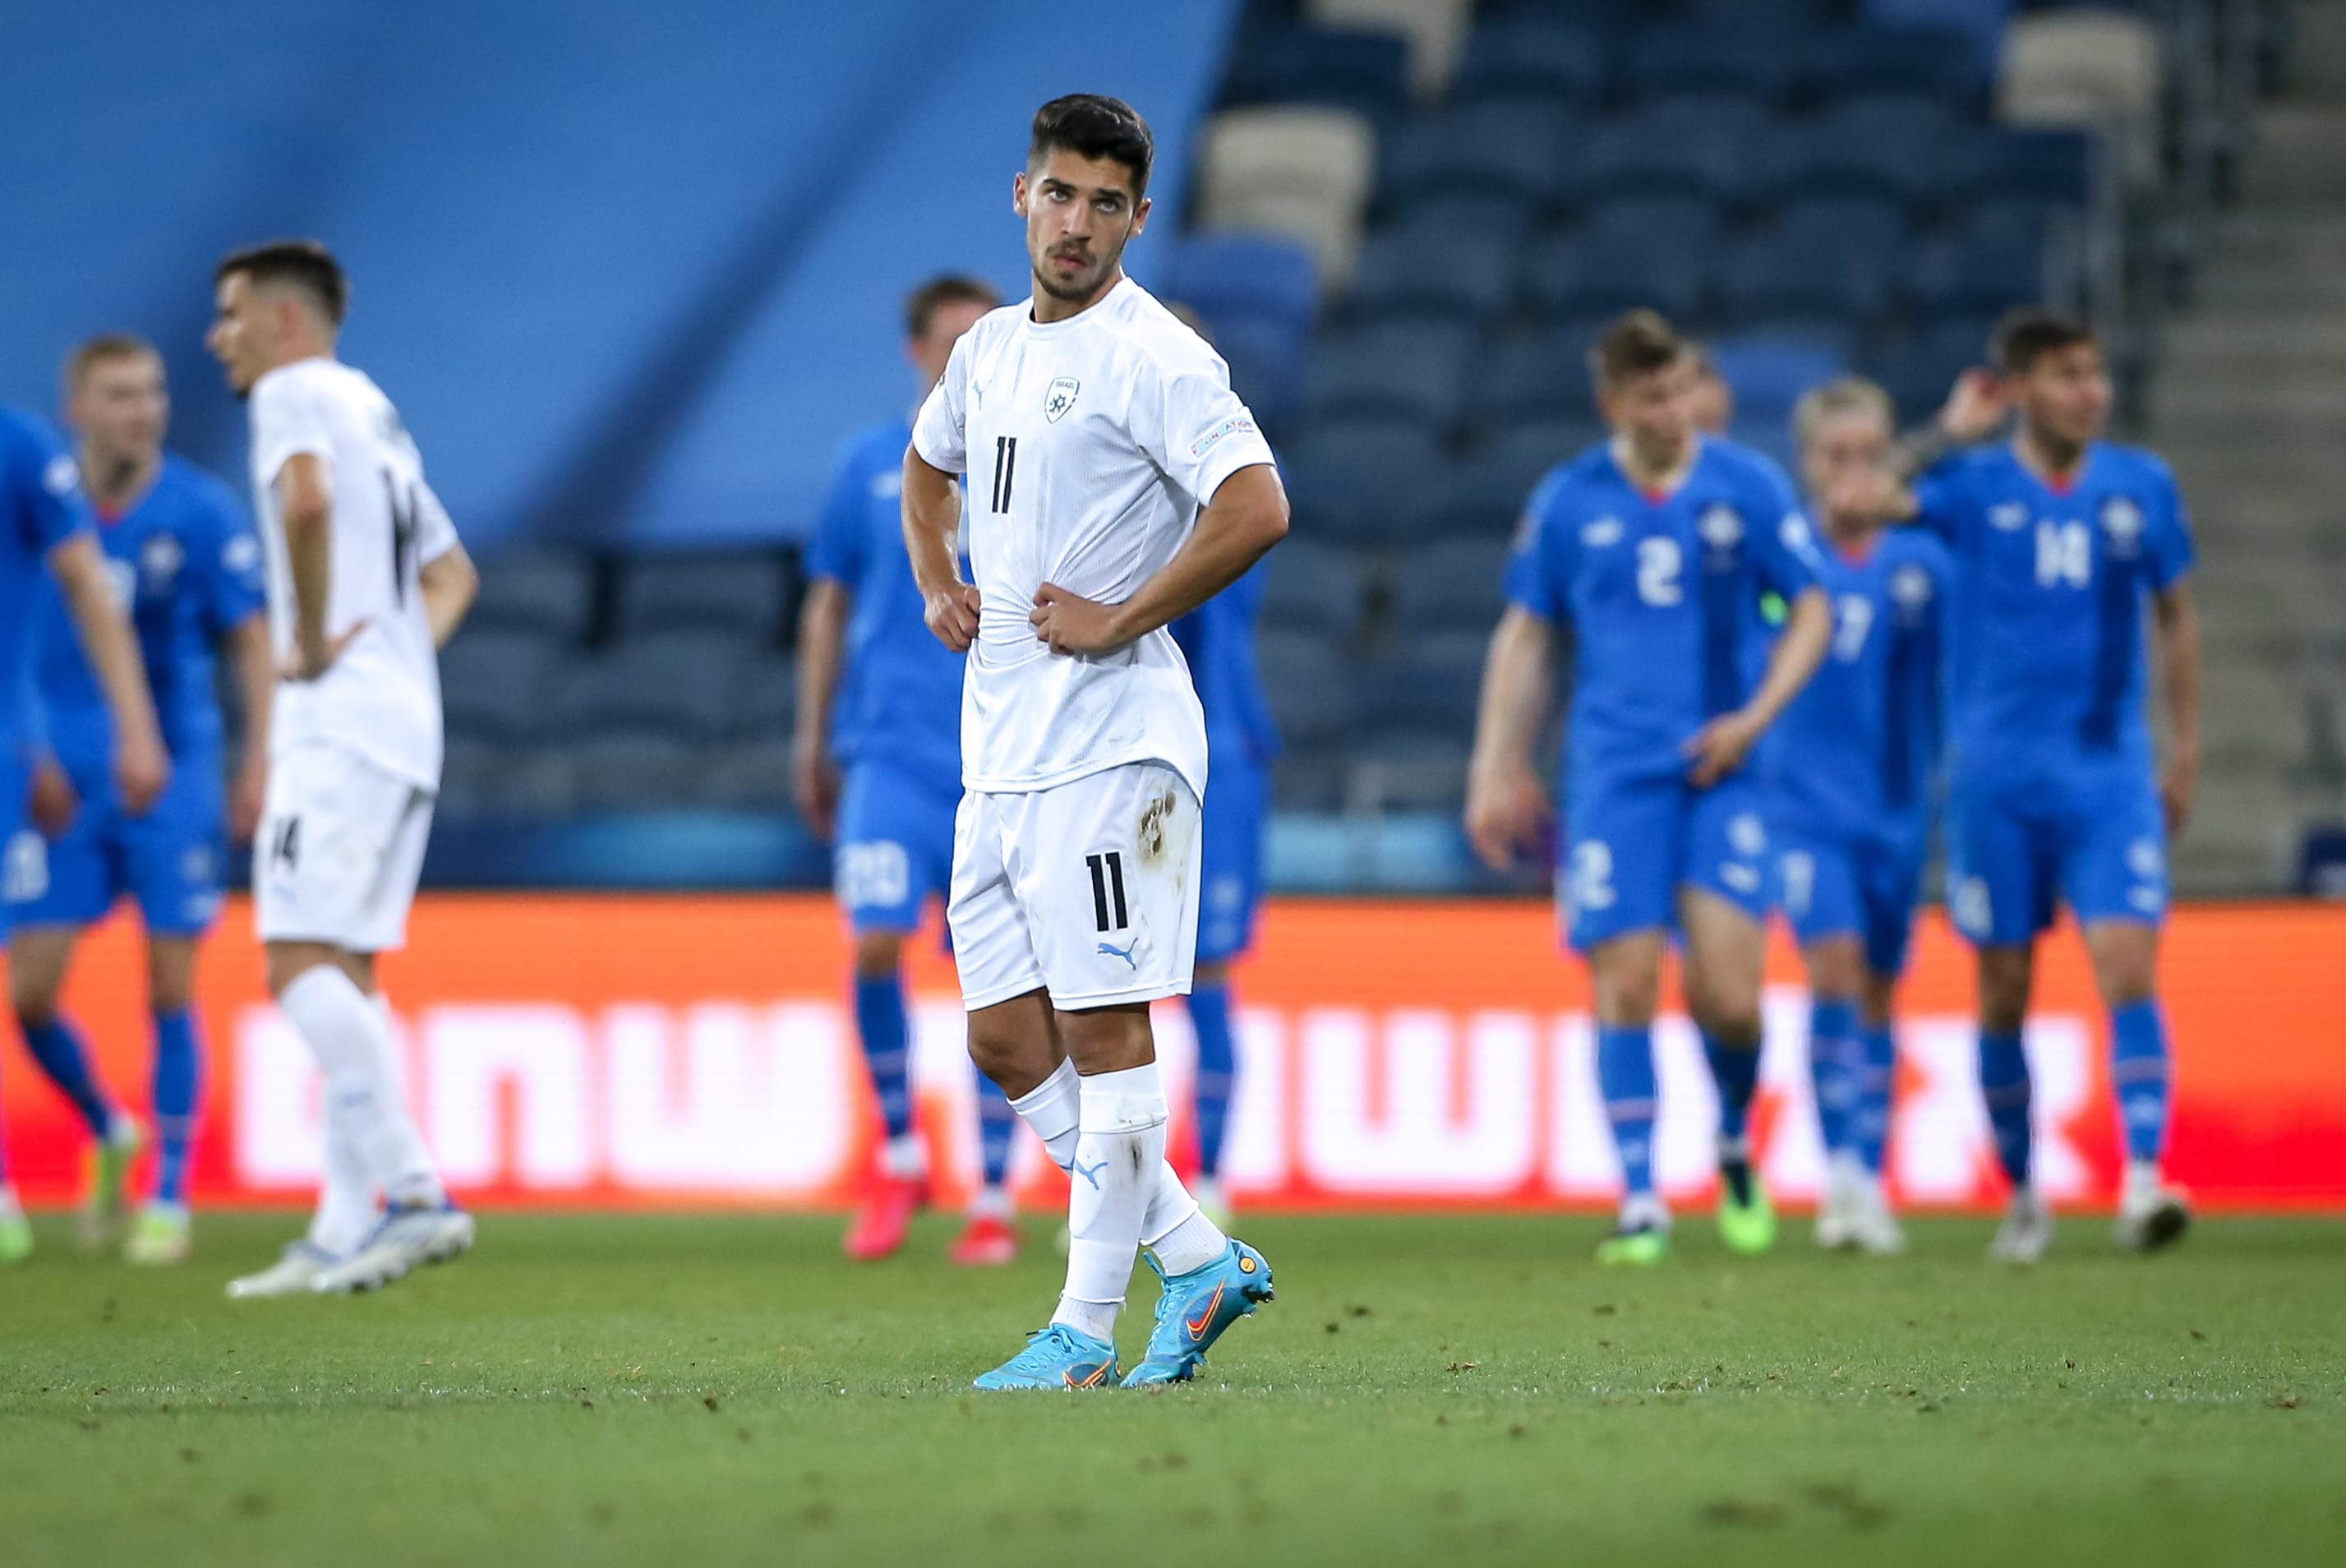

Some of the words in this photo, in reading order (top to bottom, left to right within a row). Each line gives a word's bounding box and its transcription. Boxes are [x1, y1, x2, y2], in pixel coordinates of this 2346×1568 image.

[991, 436, 1017, 514] 11
[1636, 536, 1683, 606] 2
[272, 815, 300, 873] 14
[1085, 851, 1129, 932] 11
